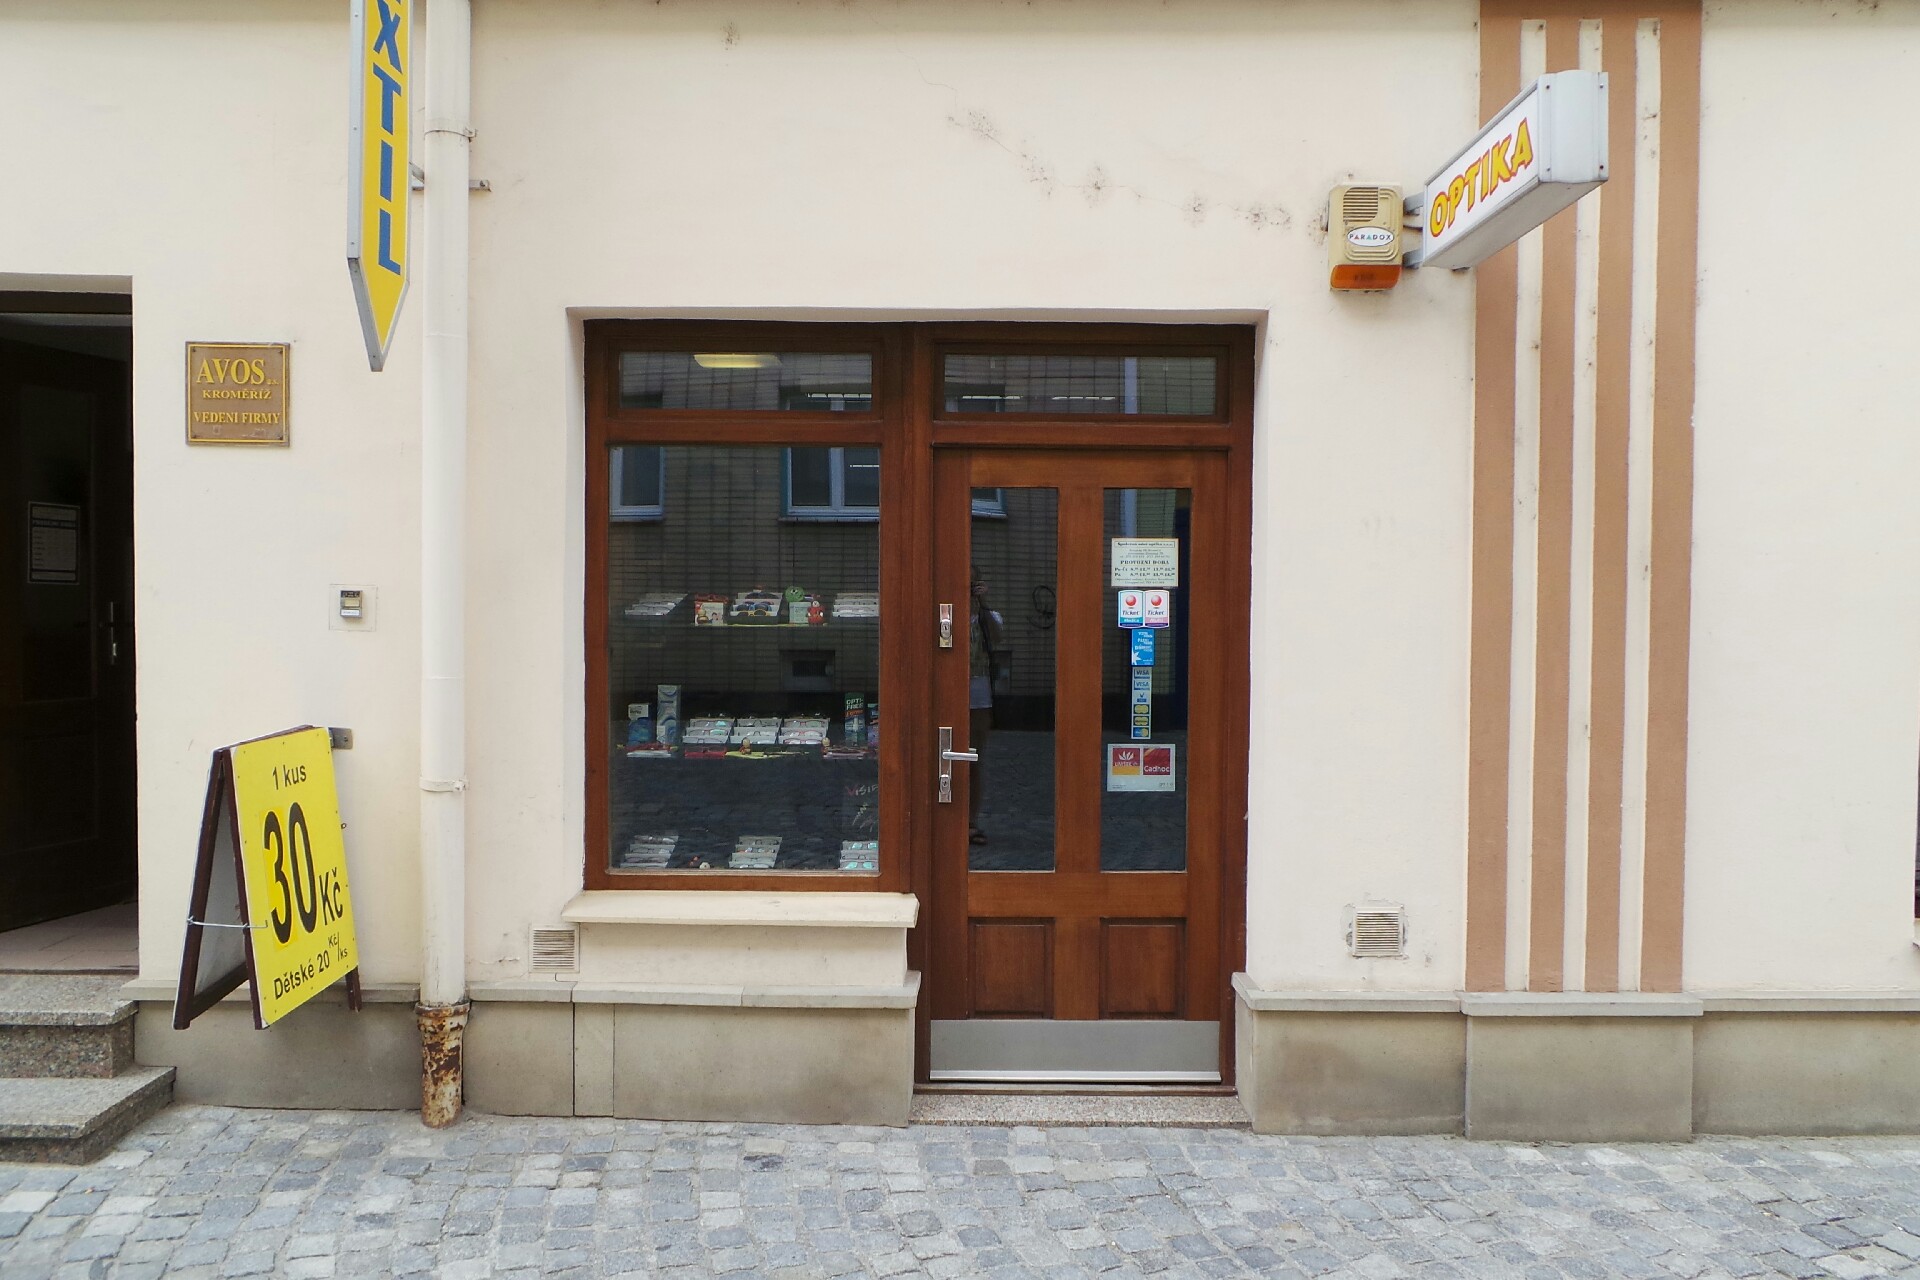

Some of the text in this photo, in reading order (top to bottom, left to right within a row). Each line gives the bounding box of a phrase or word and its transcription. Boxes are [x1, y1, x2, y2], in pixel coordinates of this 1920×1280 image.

[372, 0, 404, 276] XTIL
[1429, 117, 1534, 238] OPTIKA
[1348, 233, 1392, 241] PARADOX
[196, 357, 265, 385] AVOS
[202, 388, 272, 400] KROMĚŘÍŽ
[241, 412, 280, 424] FIRMY
[272, 764, 307, 790] 1 kus
[264, 802, 344, 945] 30 Kč
[273, 957, 315, 1000] Dětské
[317, 950, 330, 973] 20
